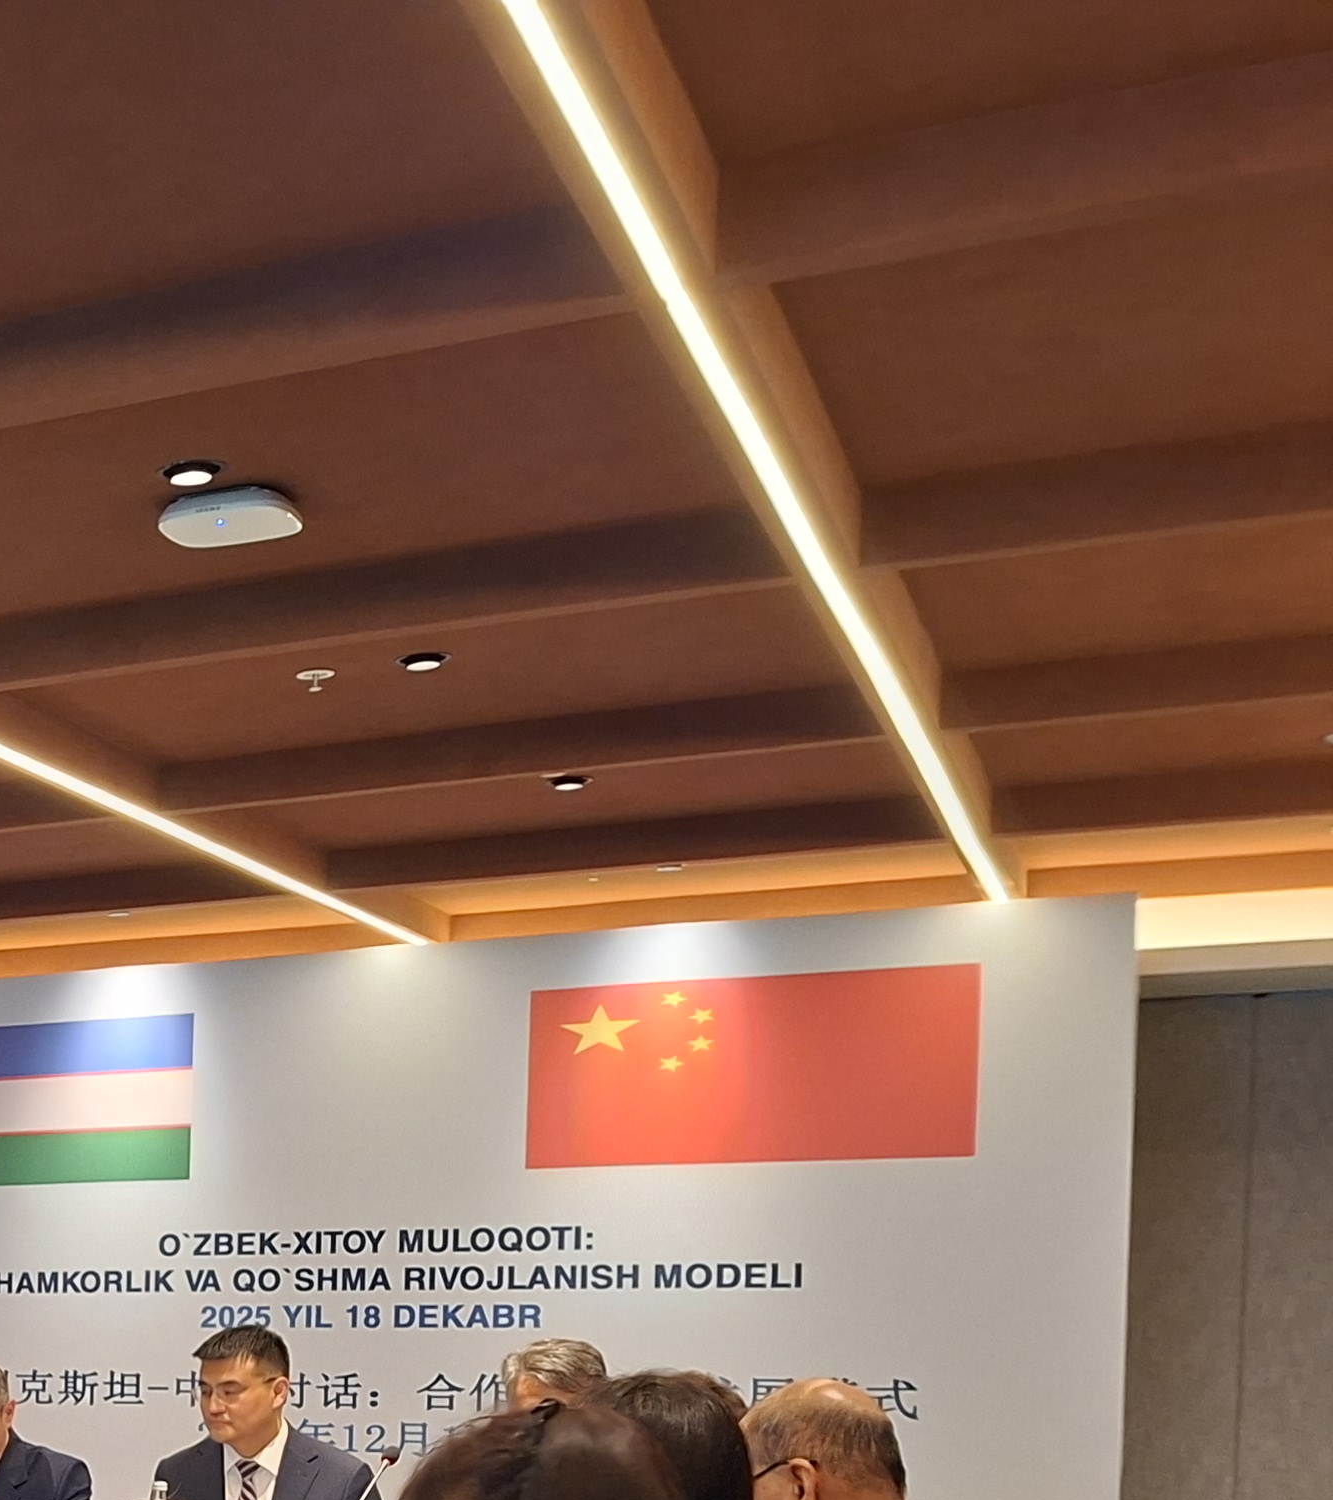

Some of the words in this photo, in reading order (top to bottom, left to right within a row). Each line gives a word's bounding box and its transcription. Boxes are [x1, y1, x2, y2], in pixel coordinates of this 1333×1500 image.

[398, 1226, 594, 1253] MULOQOTI:
[185, 1269, 221, 1293] VA
[404, 1264, 640, 1291] RIVOJLANISH
[654, 1263, 803, 1289] MODELI
[201, 1305, 271, 1329] 2025
[283, 1305, 333, 1328] YIL
[346, 1305, 381, 1328] 18
[394, 1304, 541, 1328] DEKABR
